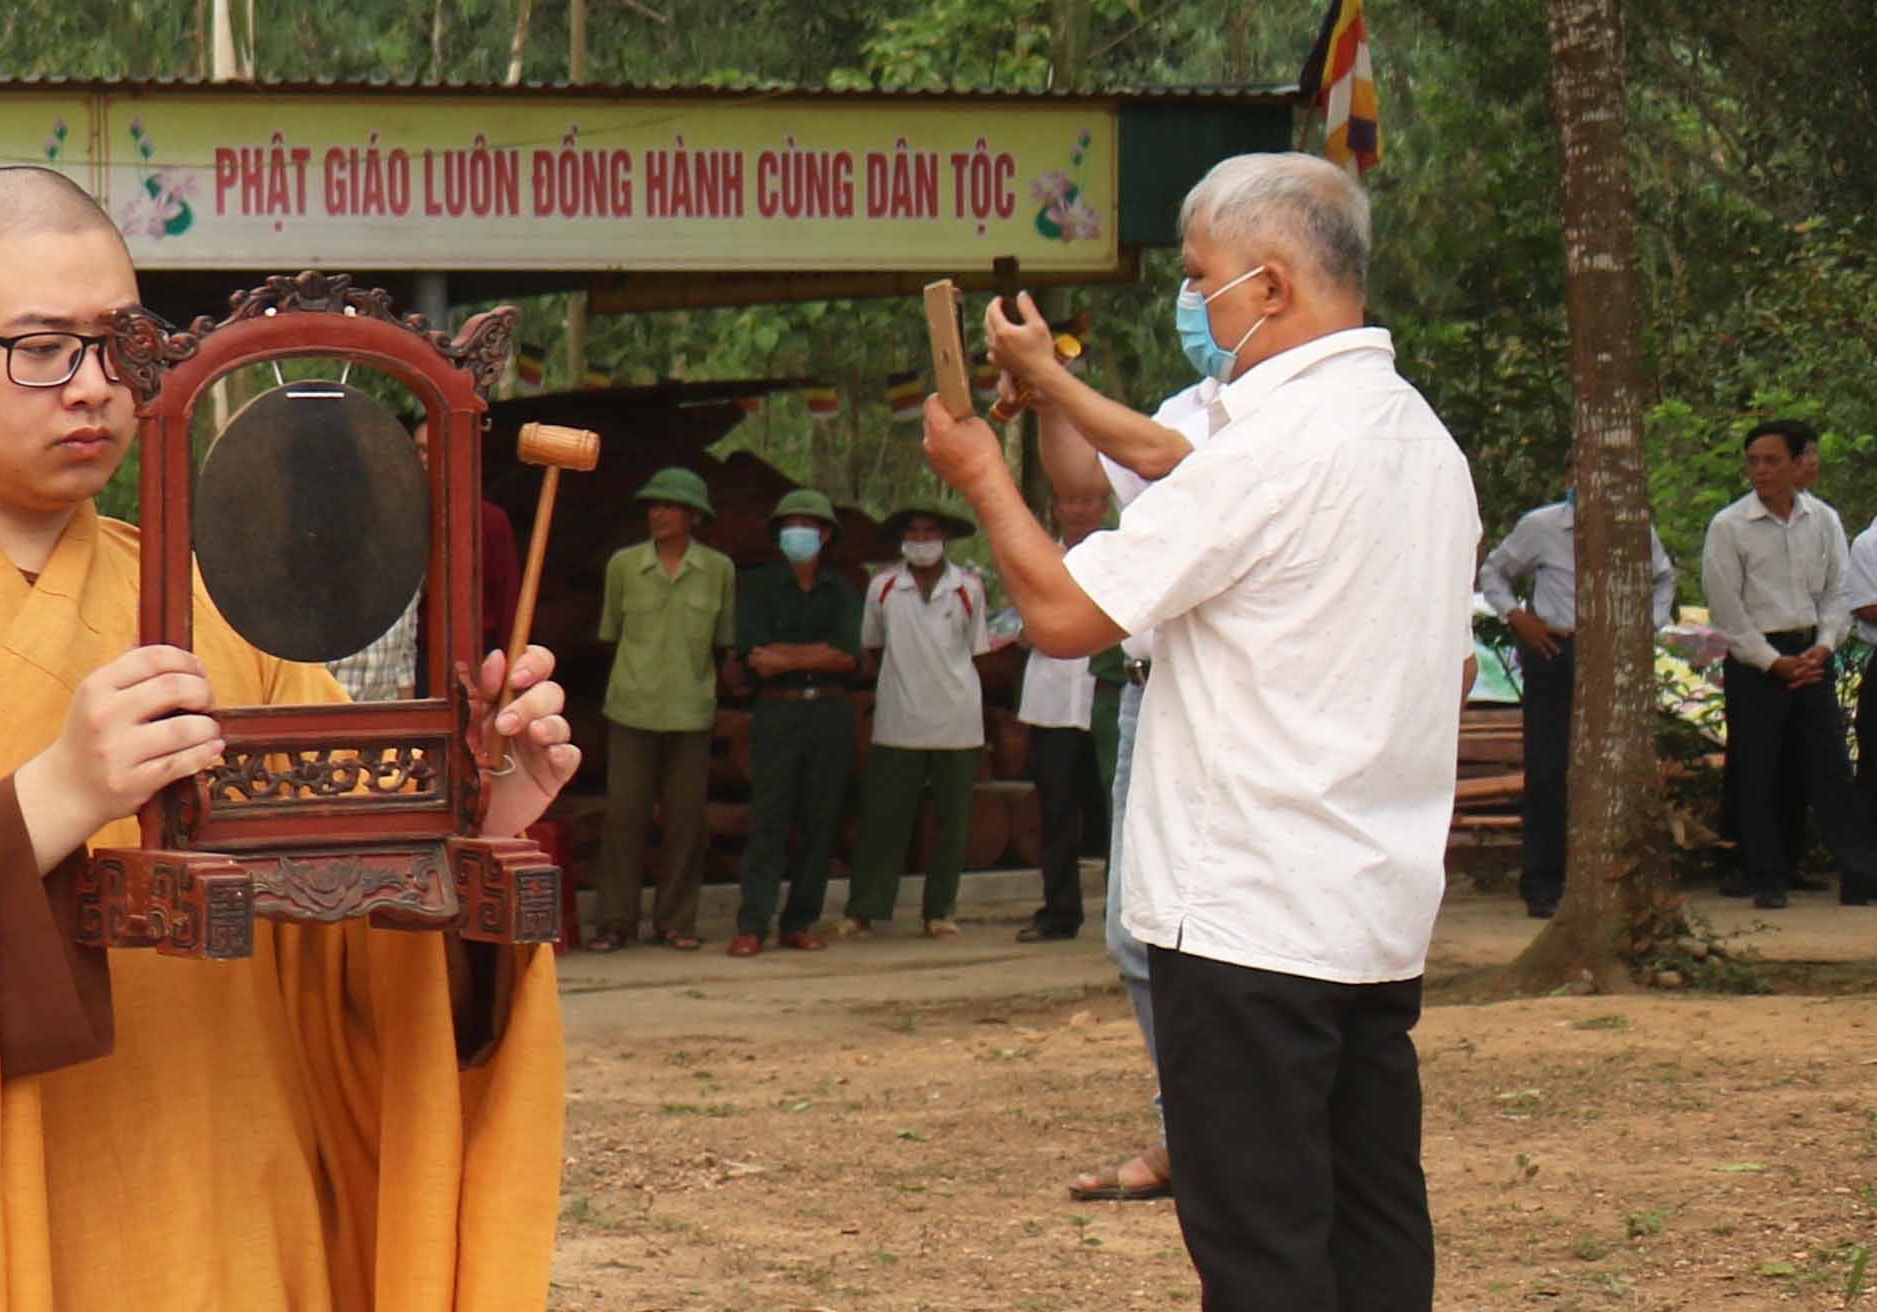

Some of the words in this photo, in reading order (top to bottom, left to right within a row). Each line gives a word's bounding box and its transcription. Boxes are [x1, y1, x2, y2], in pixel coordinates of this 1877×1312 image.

[214, 132, 311, 232] PHẬT
[324, 132, 411, 217] GIÁO
[424, 133, 520, 217] LUÔN
[532, 124, 633, 218] ĐỒNG
[646, 134, 745, 217] HÀNH
[757, 136, 855, 219] CÙNG
[866, 137, 939, 219] DÂN
[951, 137, 1015, 235] TỘC
